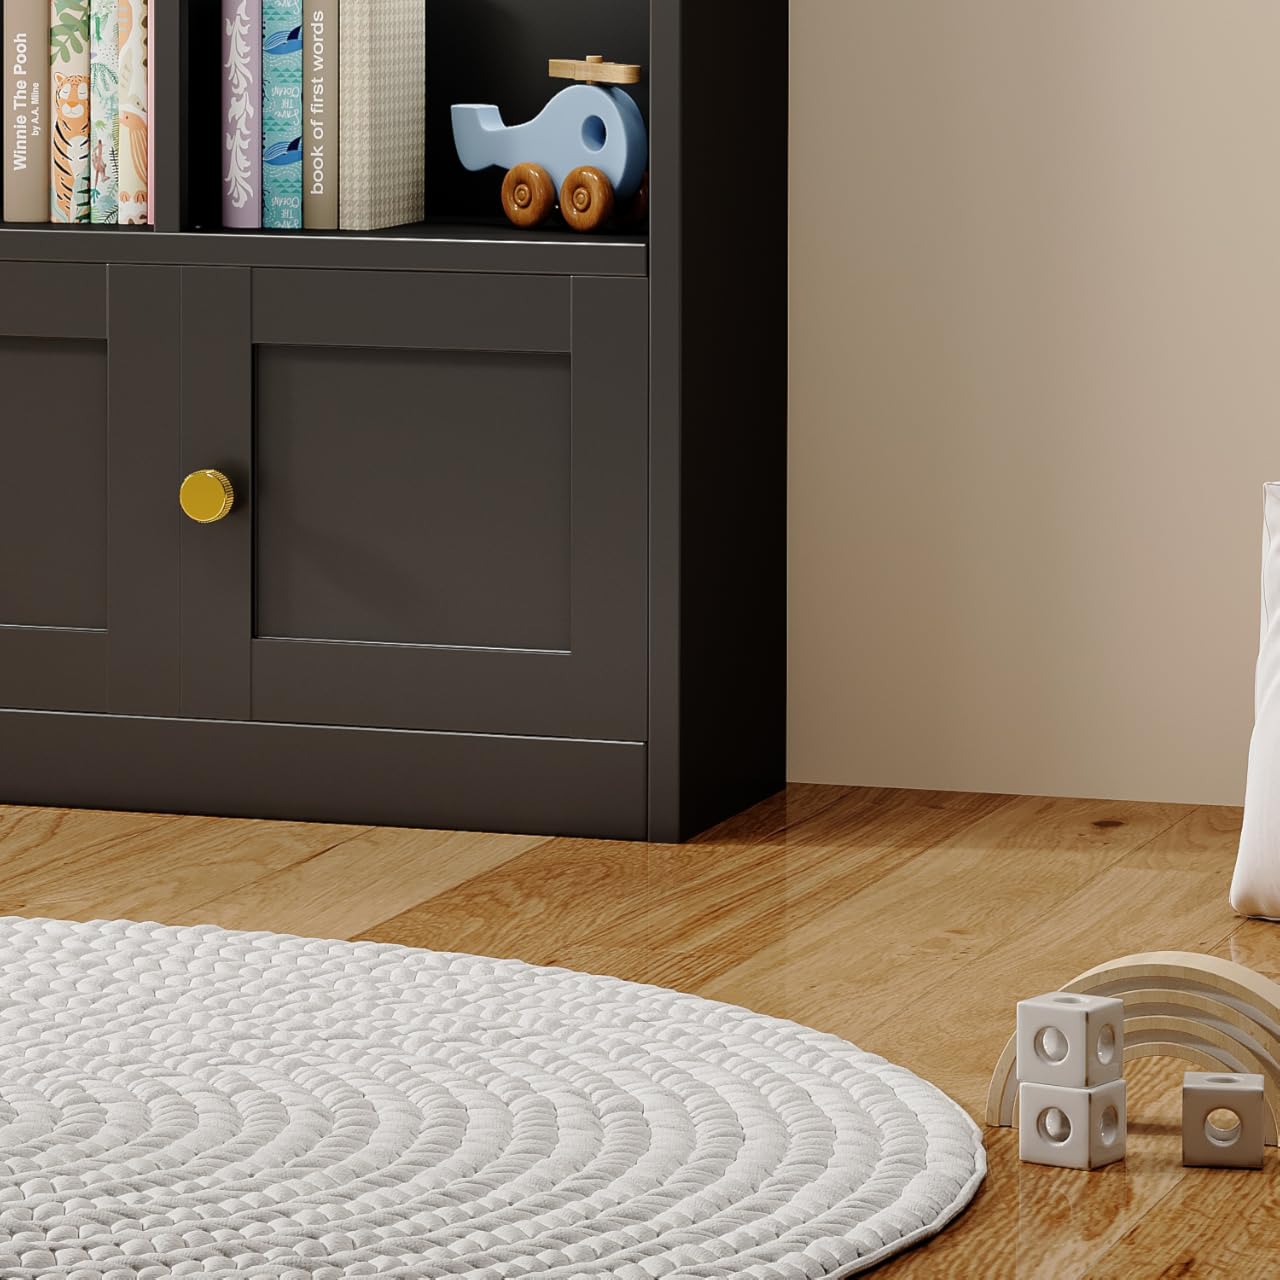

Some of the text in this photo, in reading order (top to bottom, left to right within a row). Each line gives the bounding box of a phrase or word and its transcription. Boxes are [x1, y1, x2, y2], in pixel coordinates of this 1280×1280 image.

[13, 32, 27, 172] Winnie The Pooh
[31, 82, 41, 136] by A.A. Milne
[310, 10, 324, 195] book of first words
